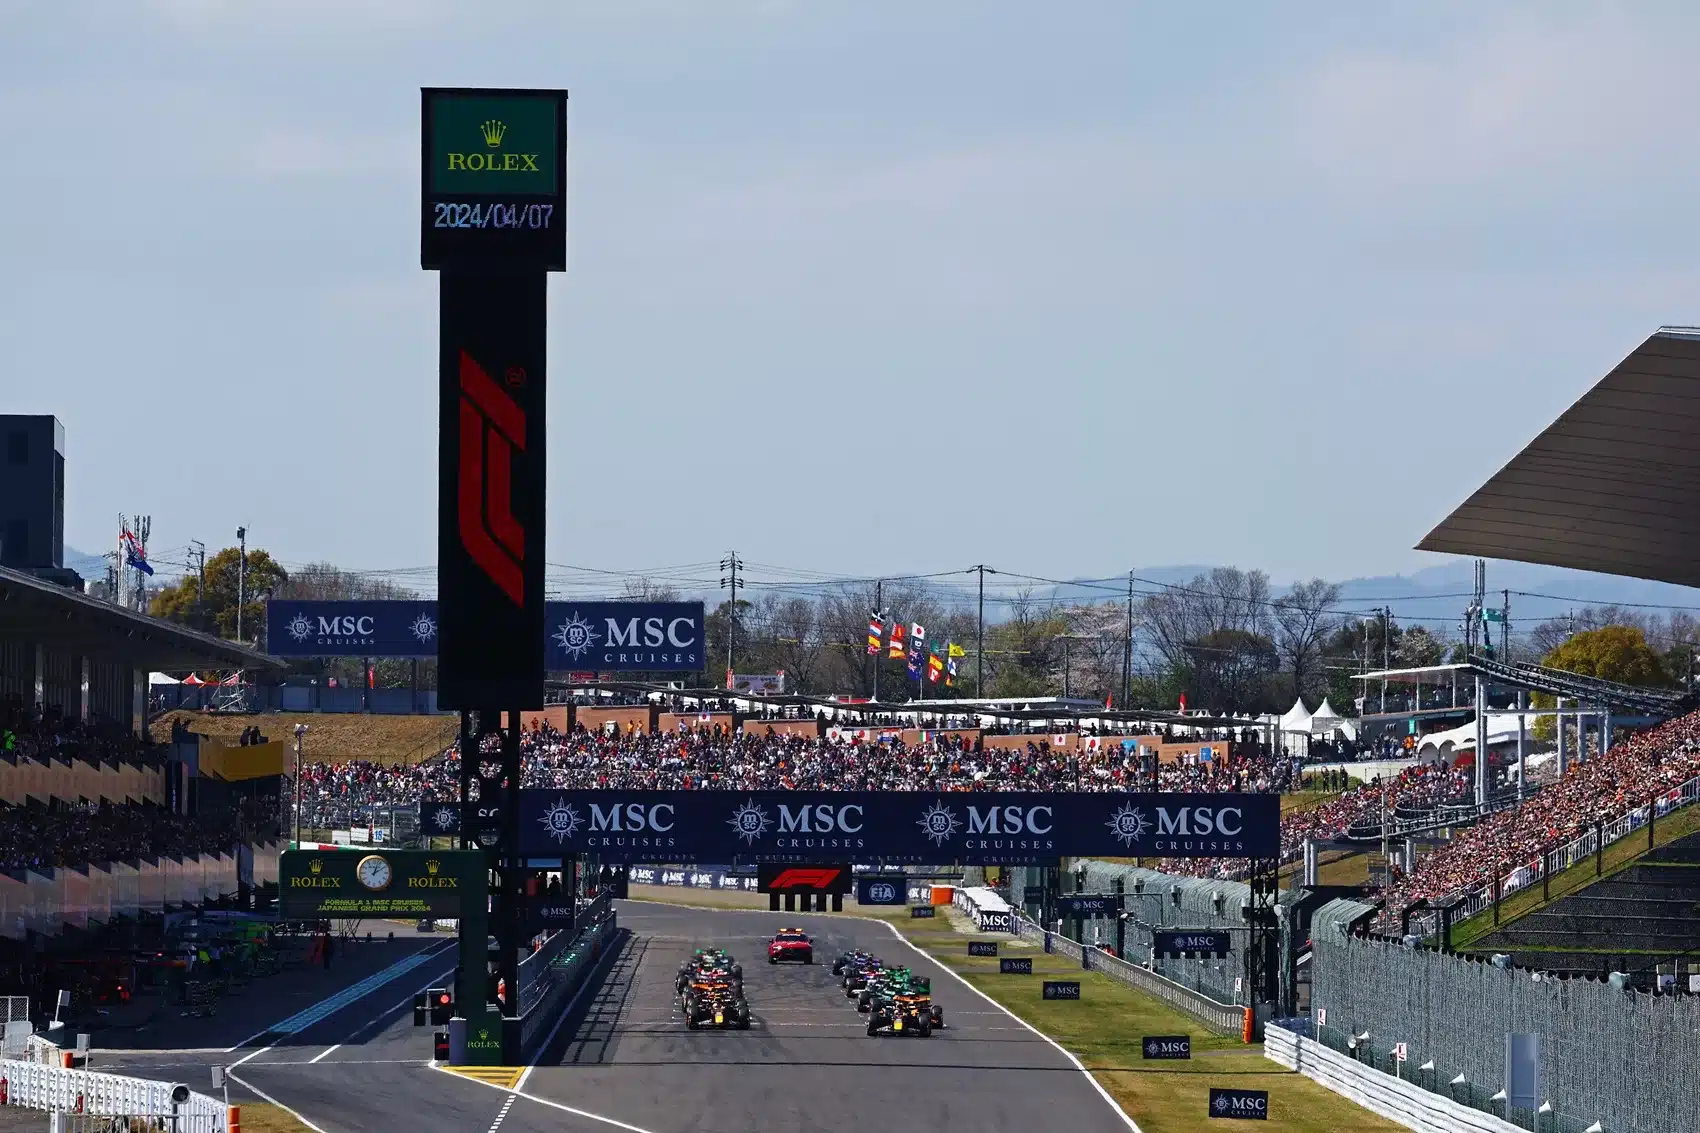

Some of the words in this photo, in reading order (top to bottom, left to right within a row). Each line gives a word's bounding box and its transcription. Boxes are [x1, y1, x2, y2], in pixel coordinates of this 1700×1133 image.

[448, 153, 539, 171] ROLEX
[434, 203, 553, 229] 2024/04/07
[317, 616, 374, 636] MSC
[604, 617, 695, 648] MSC
[604, 653, 695, 663] CRUISES
[588, 803, 675, 832] MSC
[776, 804, 864, 833] MSC
[966, 805, 1053, 834] MSC
[1155, 807, 1242, 836] MSC
[588, 838, 675, 846] CRUISES
[776, 838, 864, 848] CRUISES
[965, 840, 1053, 849] CRUISES
[1155, 841, 1243, 850] CRUISES
[290, 877, 341, 888] ROLEX
[408, 877, 458, 888] ROLEX
[1082, 901, 1104, 909] MSC
[982, 914, 1009, 926] MSC
[1187, 936, 1214, 946] MSC
[979, 944, 996, 952] MSC
[1012, 961, 1031, 969] MSC
[1057, 986, 1079, 995] MSC
[467, 1040, 500, 1048] ROLEX
[1161, 1042, 1189, 1052] MSC
[1232, 1097, 1265, 1110] MSC
